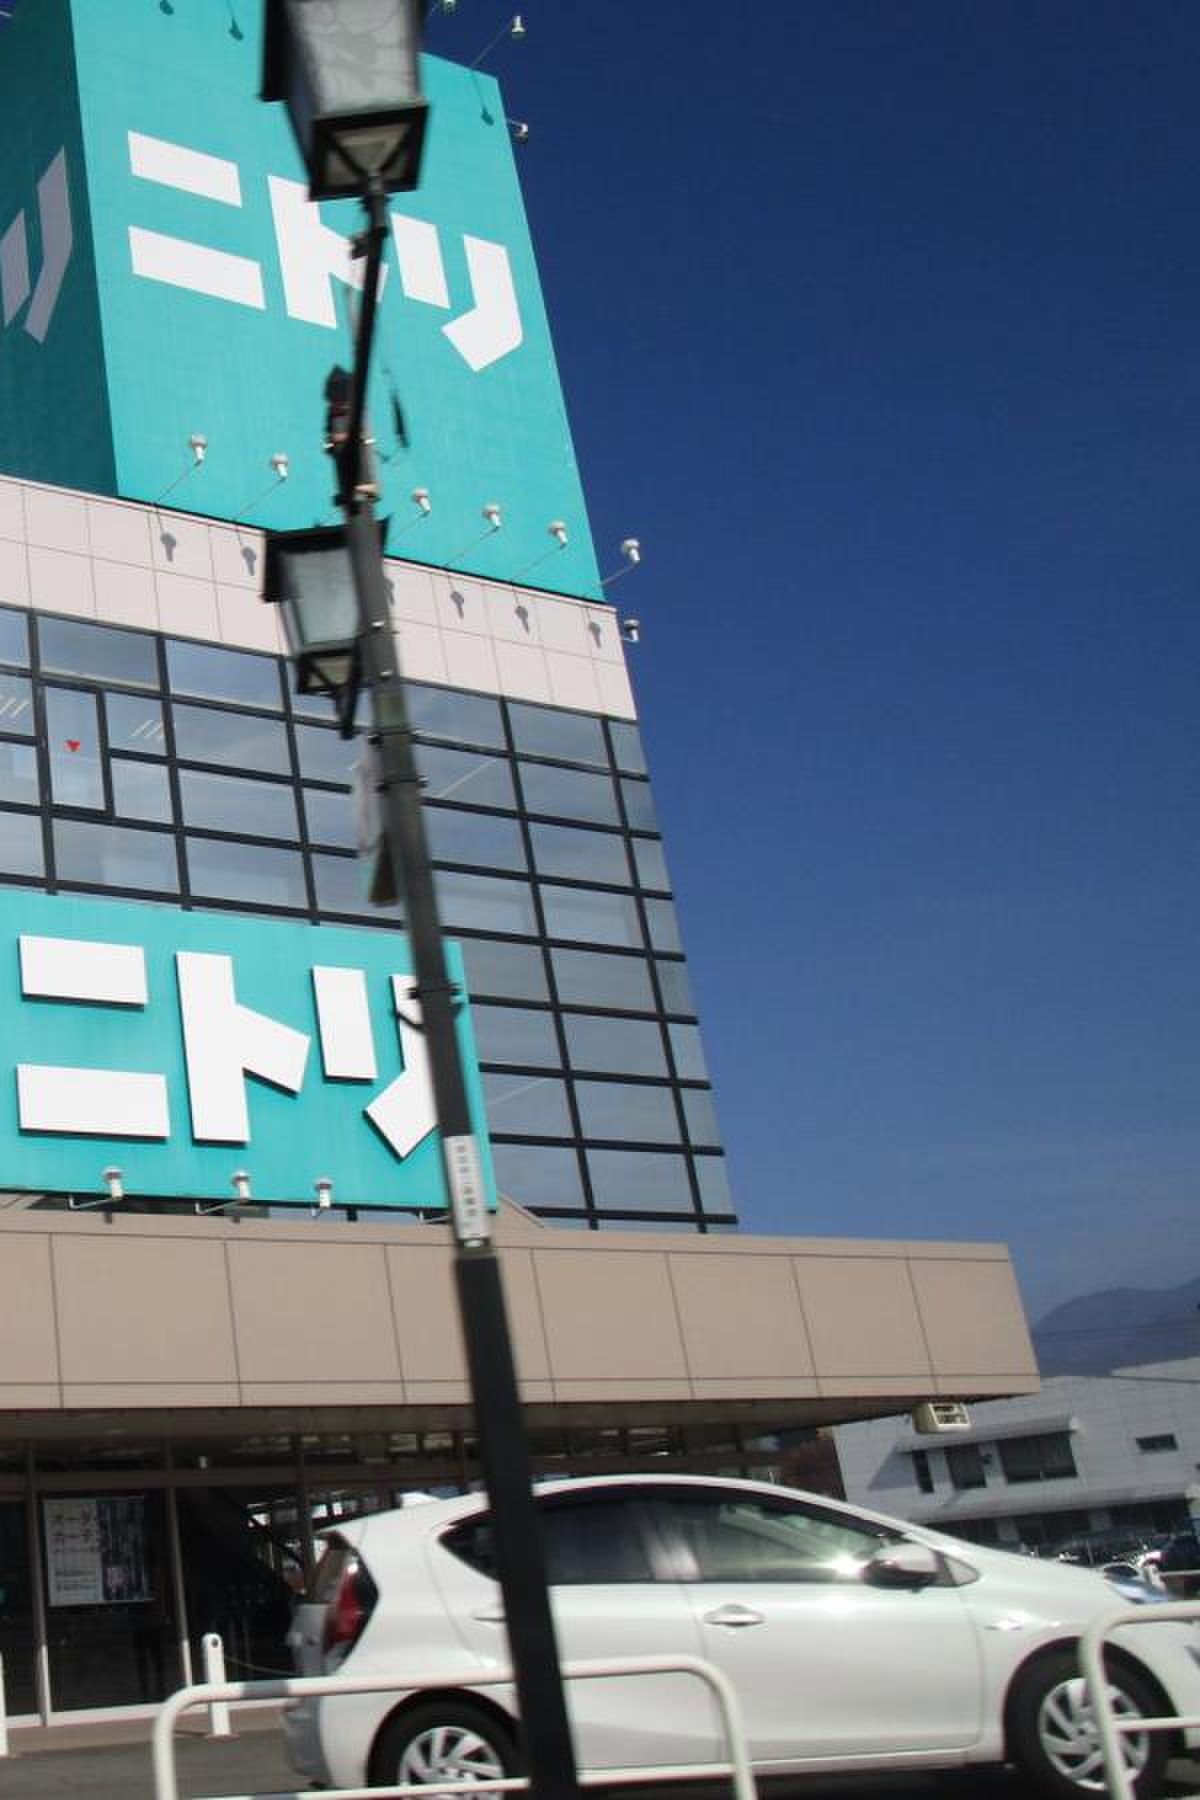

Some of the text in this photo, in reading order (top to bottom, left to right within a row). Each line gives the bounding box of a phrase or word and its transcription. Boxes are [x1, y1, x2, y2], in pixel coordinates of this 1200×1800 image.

[127, 130, 523, 371] ニトリ
[17, 935, 440, 1158] ニトリ
